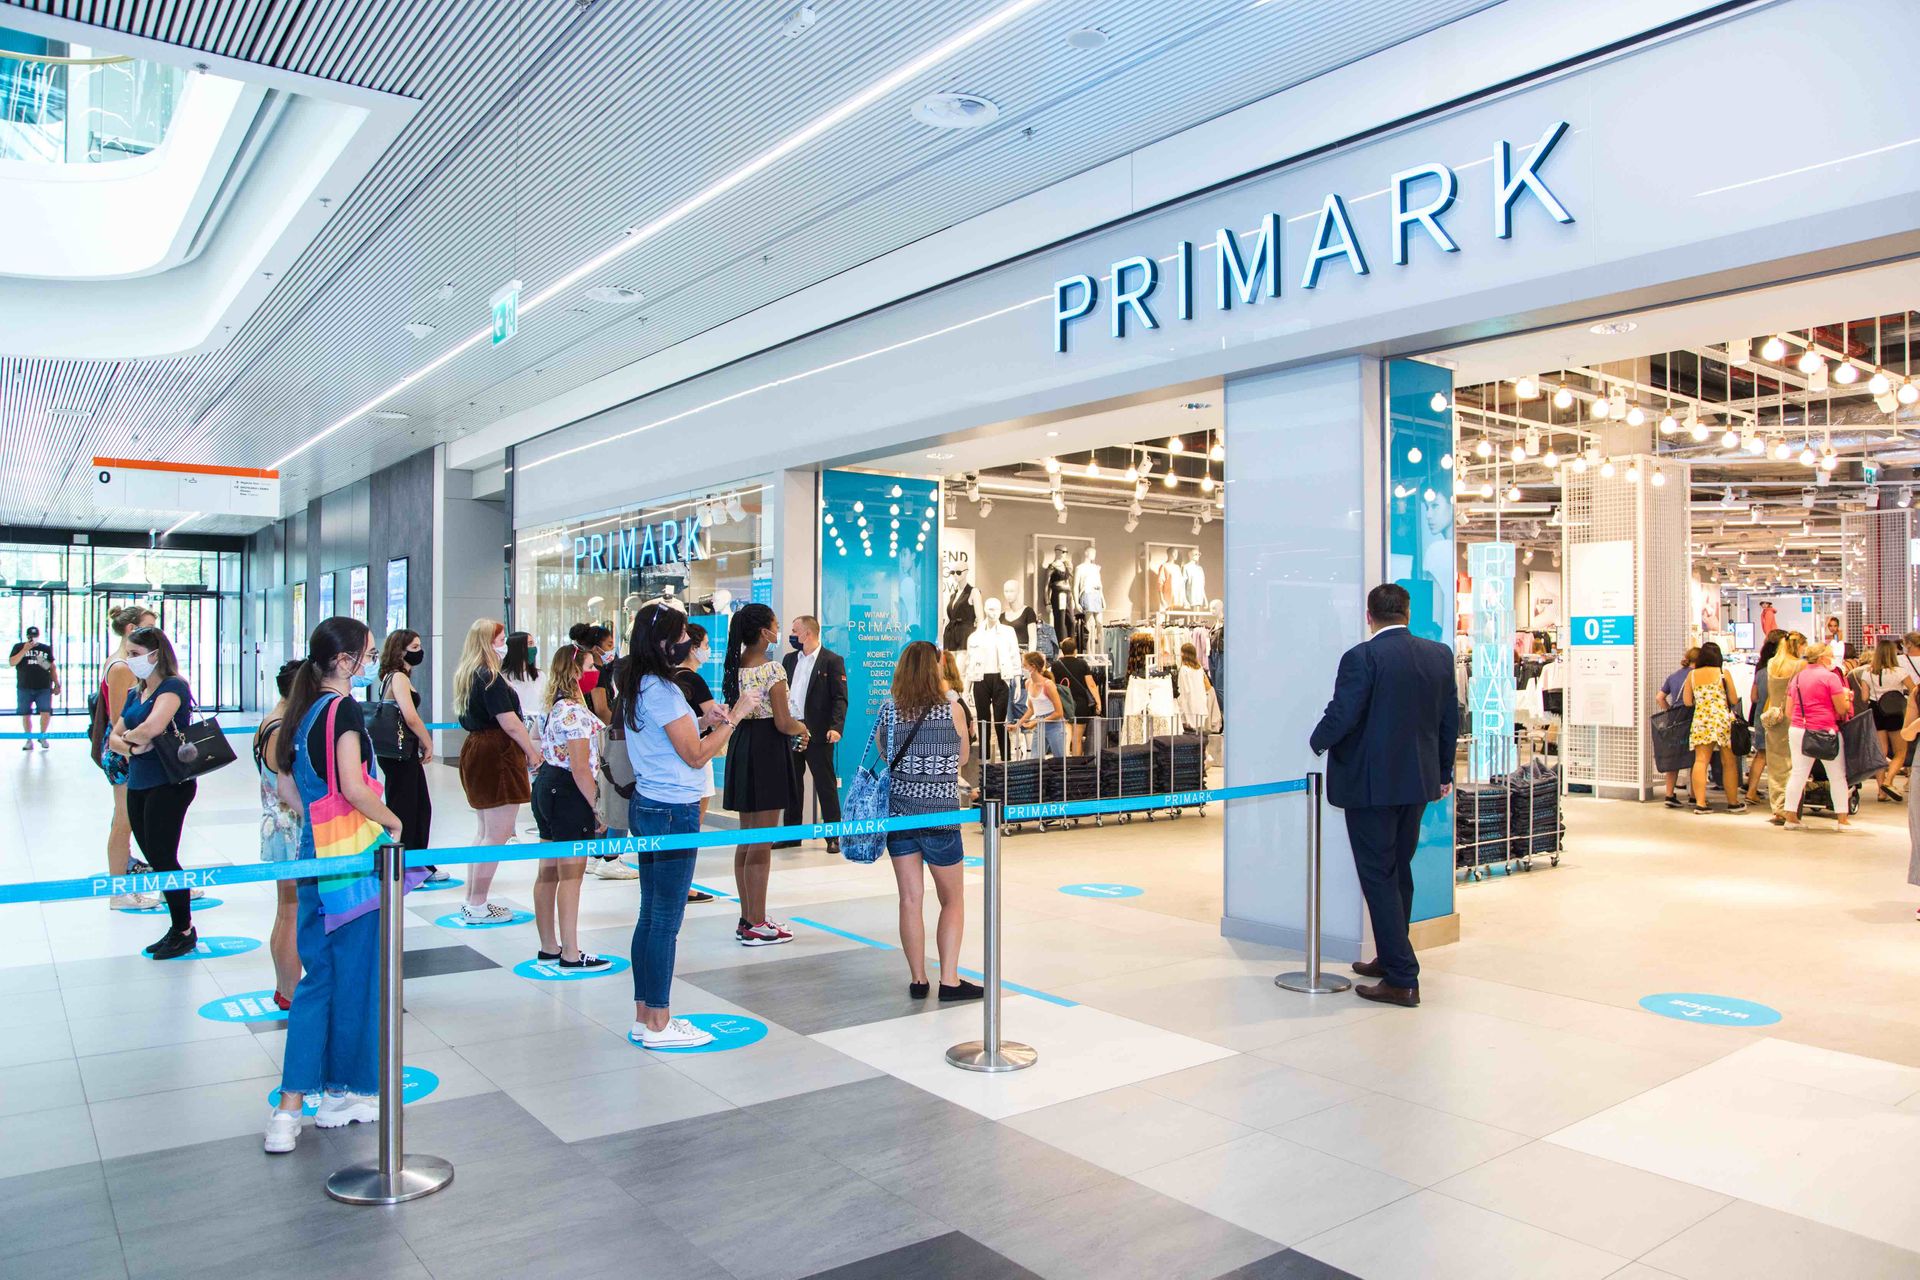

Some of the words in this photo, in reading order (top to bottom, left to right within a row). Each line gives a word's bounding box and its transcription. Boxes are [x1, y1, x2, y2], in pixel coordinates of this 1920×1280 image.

[1054, 121, 1575, 352] PRIMARK
[573, 515, 706, 577] PRIMARK
[864, 611, 890, 619] WITAMY
[848, 620, 912, 632] PRIMARK
[1584, 618, 1600, 641] 0
[870, 669, 891, 677] DZIECI
[868, 688, 892, 696] URODA
[1164, 791, 1213, 806] PRIMARK
[1008, 803, 1067, 818] PRIMARK
[813, 820, 887, 838] PRIMARK
[573, 837, 663, 856] PRIMARK
[93, 869, 218, 896] PRIMARK
